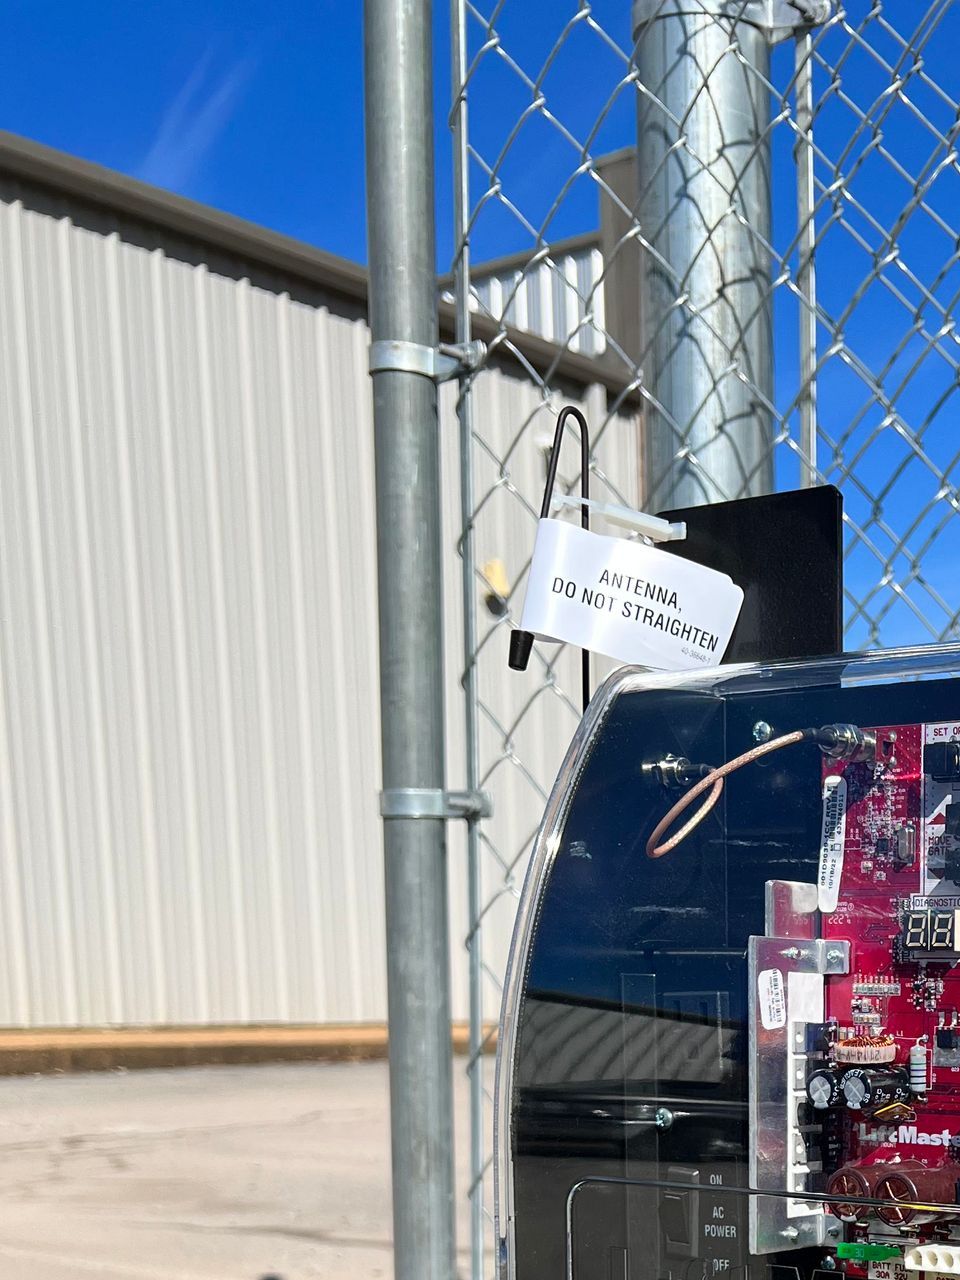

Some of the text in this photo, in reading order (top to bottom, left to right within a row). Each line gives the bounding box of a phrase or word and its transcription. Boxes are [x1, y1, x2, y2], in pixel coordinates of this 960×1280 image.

[599, 569, 682, 613] ANTENNA,
[552, 577, 719, 652] DO NOT STRAIGHTEN
[933, 727, 948, 736] SET
[928, 836, 951, 846] MOVE
[709, 1173, 723, 1186] ON
[712, 1206, 725, 1219] AC
[704, 1224, 737, 1238] POWER
[712, 1258, 730, 1271] OFF
[872, 1261, 891, 1270] BATT
[875, 1270, 908, 1280] 30A 32V
